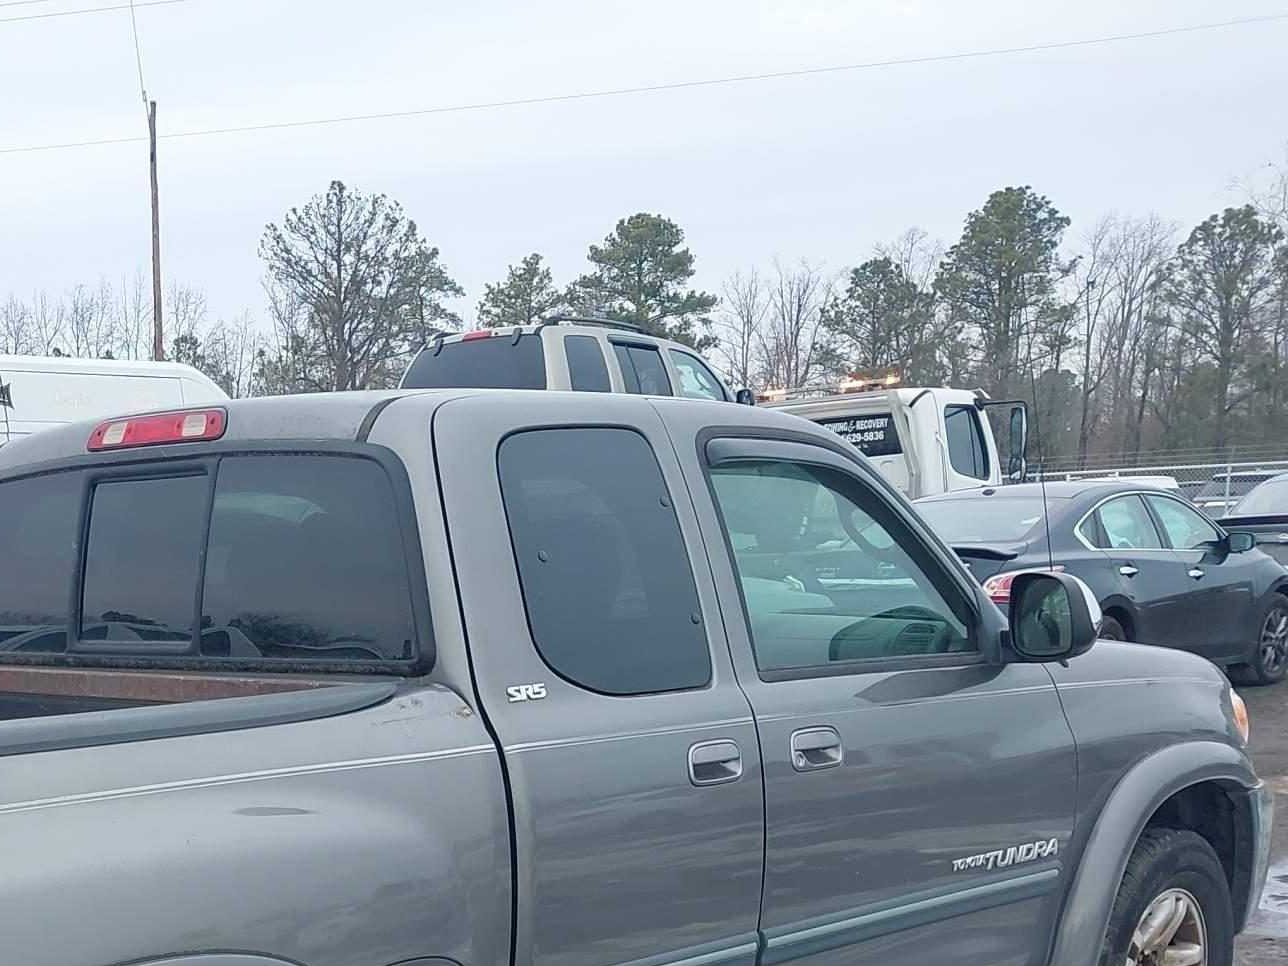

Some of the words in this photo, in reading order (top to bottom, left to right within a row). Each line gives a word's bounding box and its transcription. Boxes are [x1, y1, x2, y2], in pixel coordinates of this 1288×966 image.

[848, 420, 856, 432] &
[856, 418, 889, 430] RECOVERY
[846, 431, 884, 443] 629-5836
[507, 683, 547, 703] SR5
[952, 854, 987, 872] TOYOTA
[985, 837, 1059, 870] TUNDRA
